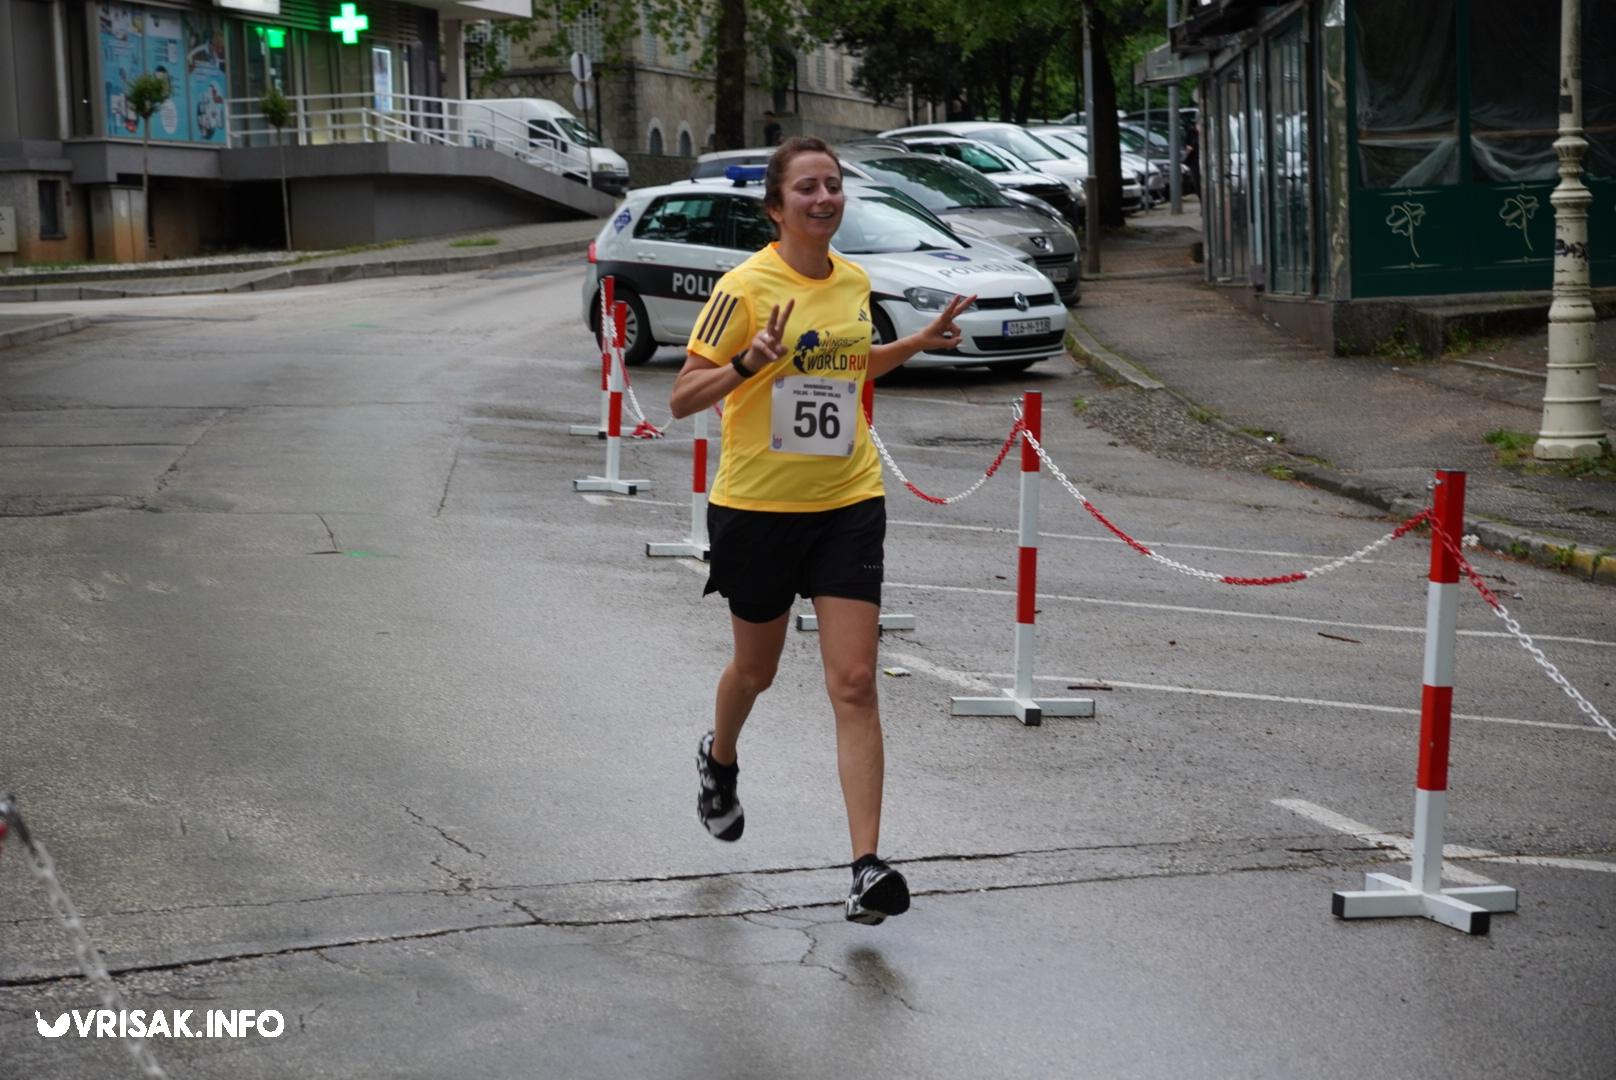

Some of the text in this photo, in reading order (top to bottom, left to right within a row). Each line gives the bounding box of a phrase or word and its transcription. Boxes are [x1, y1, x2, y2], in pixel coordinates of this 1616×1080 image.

[938, 262, 1032, 278] POLICIJA
[672, 272, 713, 297] POLI
[807, 354, 848, 371] WORLD
[793, 401, 840, 439] 56
